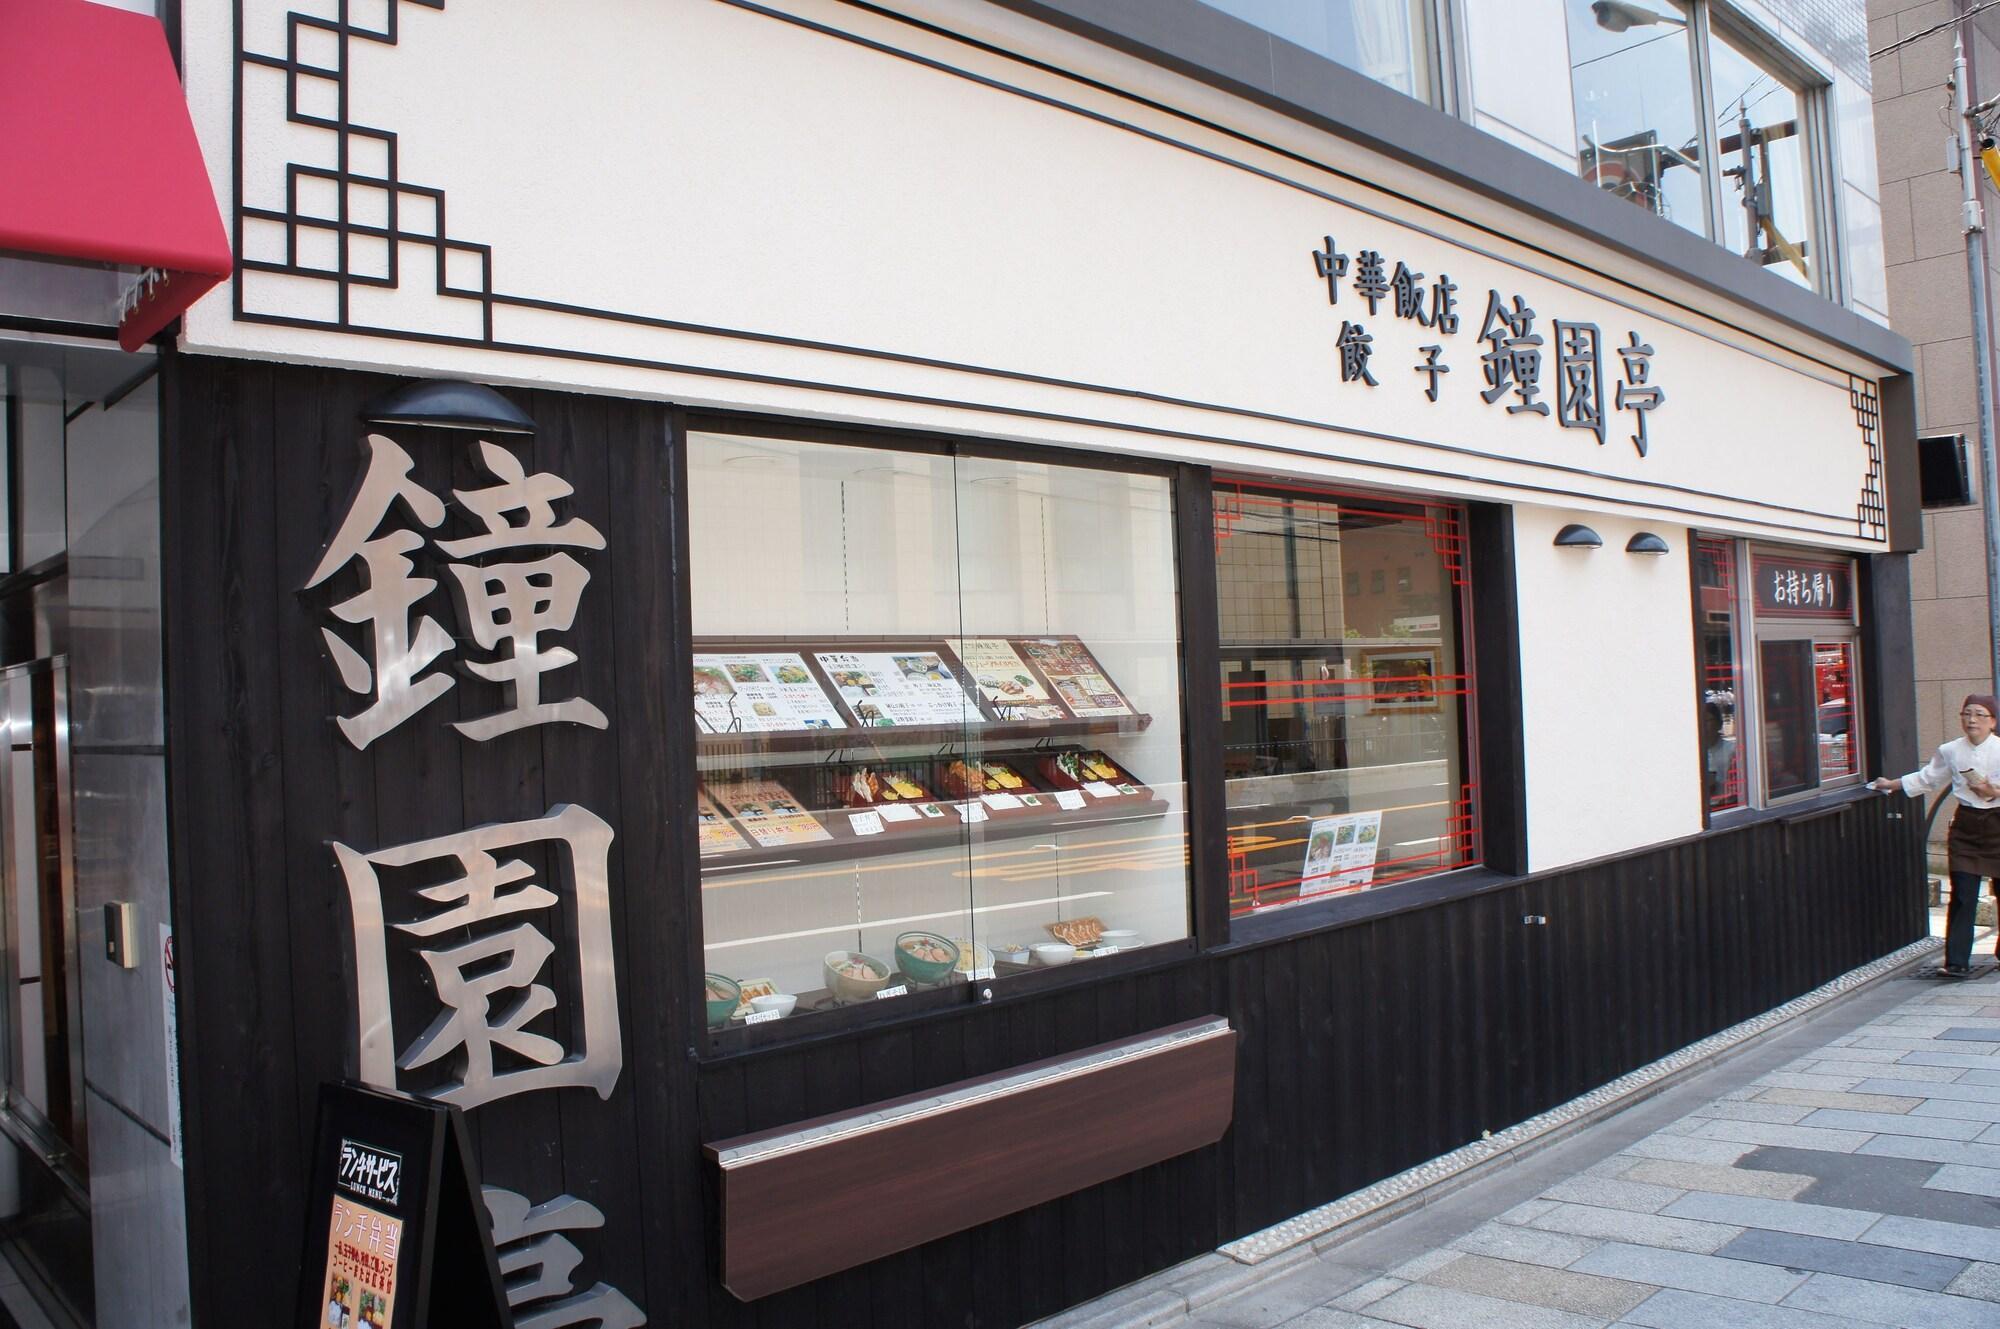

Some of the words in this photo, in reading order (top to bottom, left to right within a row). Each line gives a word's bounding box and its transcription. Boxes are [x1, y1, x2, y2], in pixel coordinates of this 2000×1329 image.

[1312, 235, 1460, 335] 中華飯店
[1335, 320, 1450, 403] 餃子
[1477, 288, 1666, 458] 鐘園亭
[1773, 569, 1835, 608] お持ち帰り
[341, 1146, 398, 1194] ランチサービス
[350, 1181, 366, 1195] LUNCH
[368, 1187, 382, 1200] MENU
[334, 1202, 398, 1260] ランチ弁当
